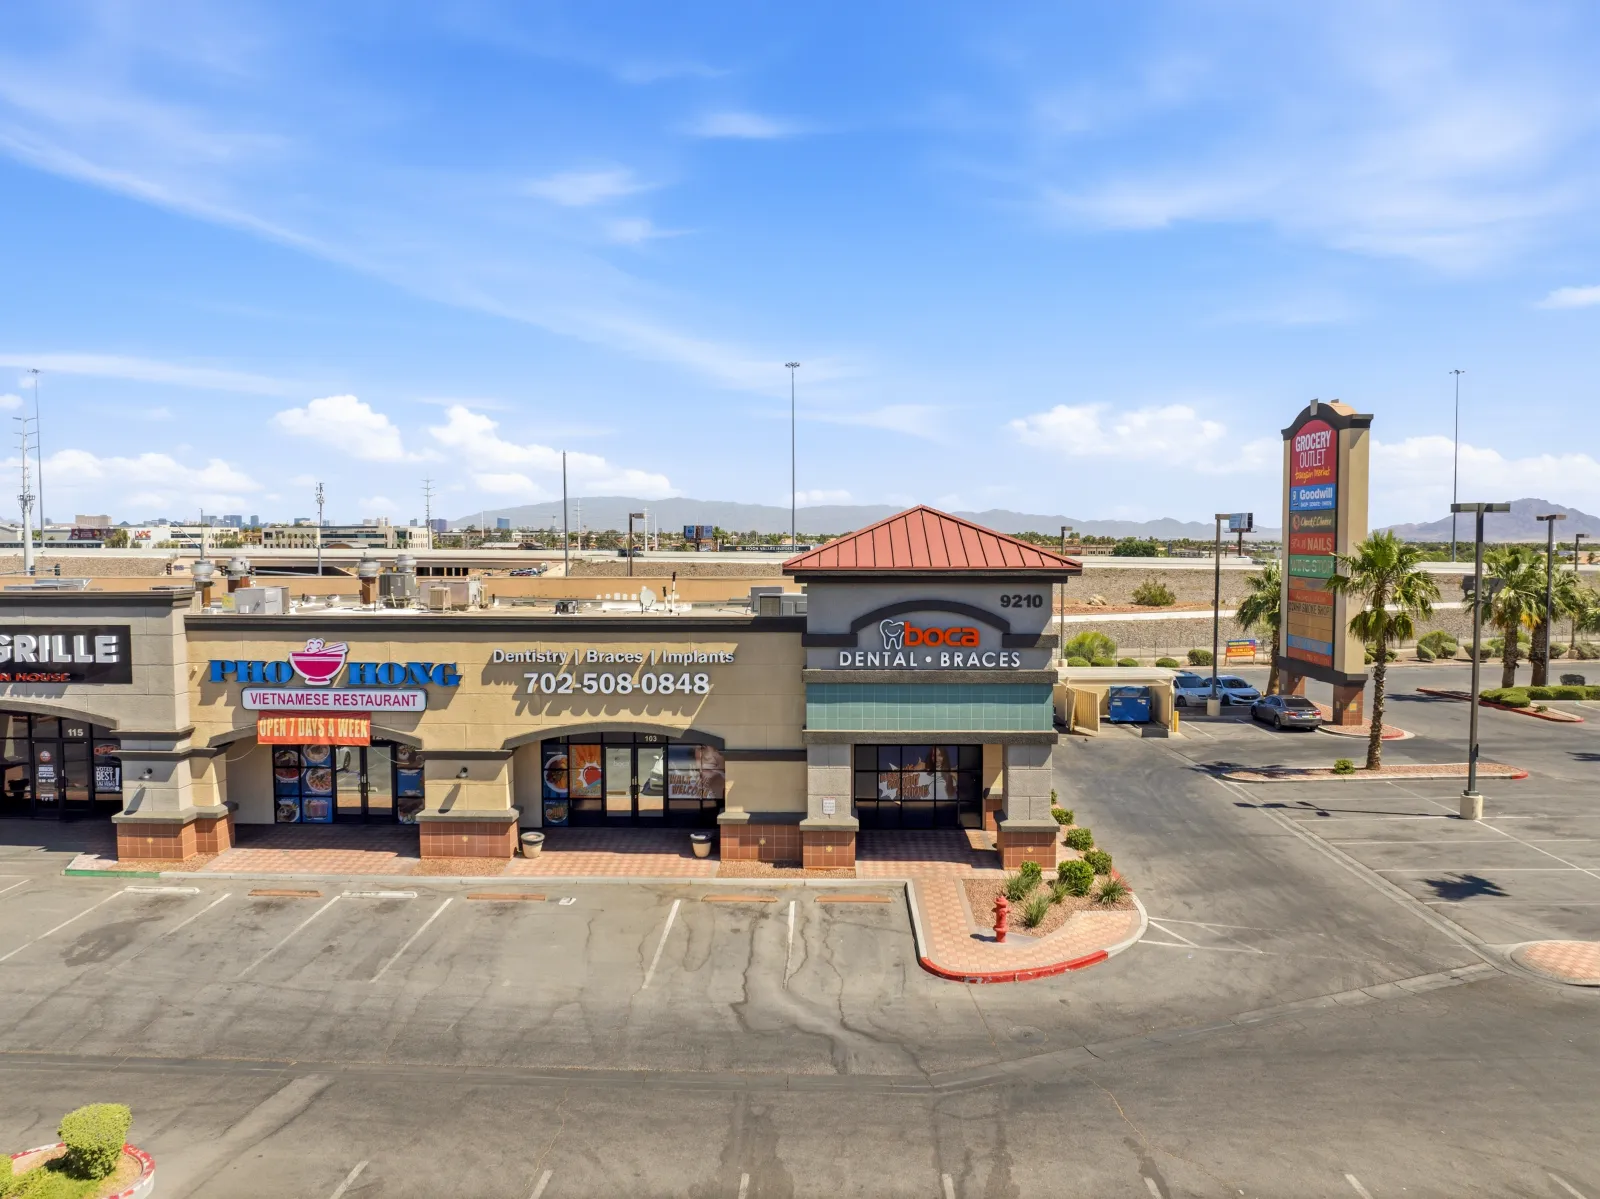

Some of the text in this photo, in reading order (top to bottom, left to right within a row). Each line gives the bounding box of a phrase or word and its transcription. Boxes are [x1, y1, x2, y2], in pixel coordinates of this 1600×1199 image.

[1295, 430, 1331, 452] GROCERY
[1300, 449, 1326, 468] OUTLET
[1299, 487, 1333, 500] Goodwill
[1307, 537, 1332, 551] NAILS
[1000, 594, 1043, 608] 9210
[904, 620, 980, 649] boca
[493, 649, 567, 666] Dentistry
[586, 649, 643, 663] Braces
[662, 649, 735, 666] Implants
[839, 651, 1021, 668] DENTAL BRACES
[15, 672, 71, 682] HOUSE
[208, 659, 463, 687] PHO HONG
[523, 672, 711, 695] 702-508-0848
[250, 692, 418, 707] VIETNAMESE RESTAURANT
[67, 728, 84, 737] 115
[259, 718, 369, 738] OPEN 7 DAYS A WEEK
[645, 735, 657, 743] 103
